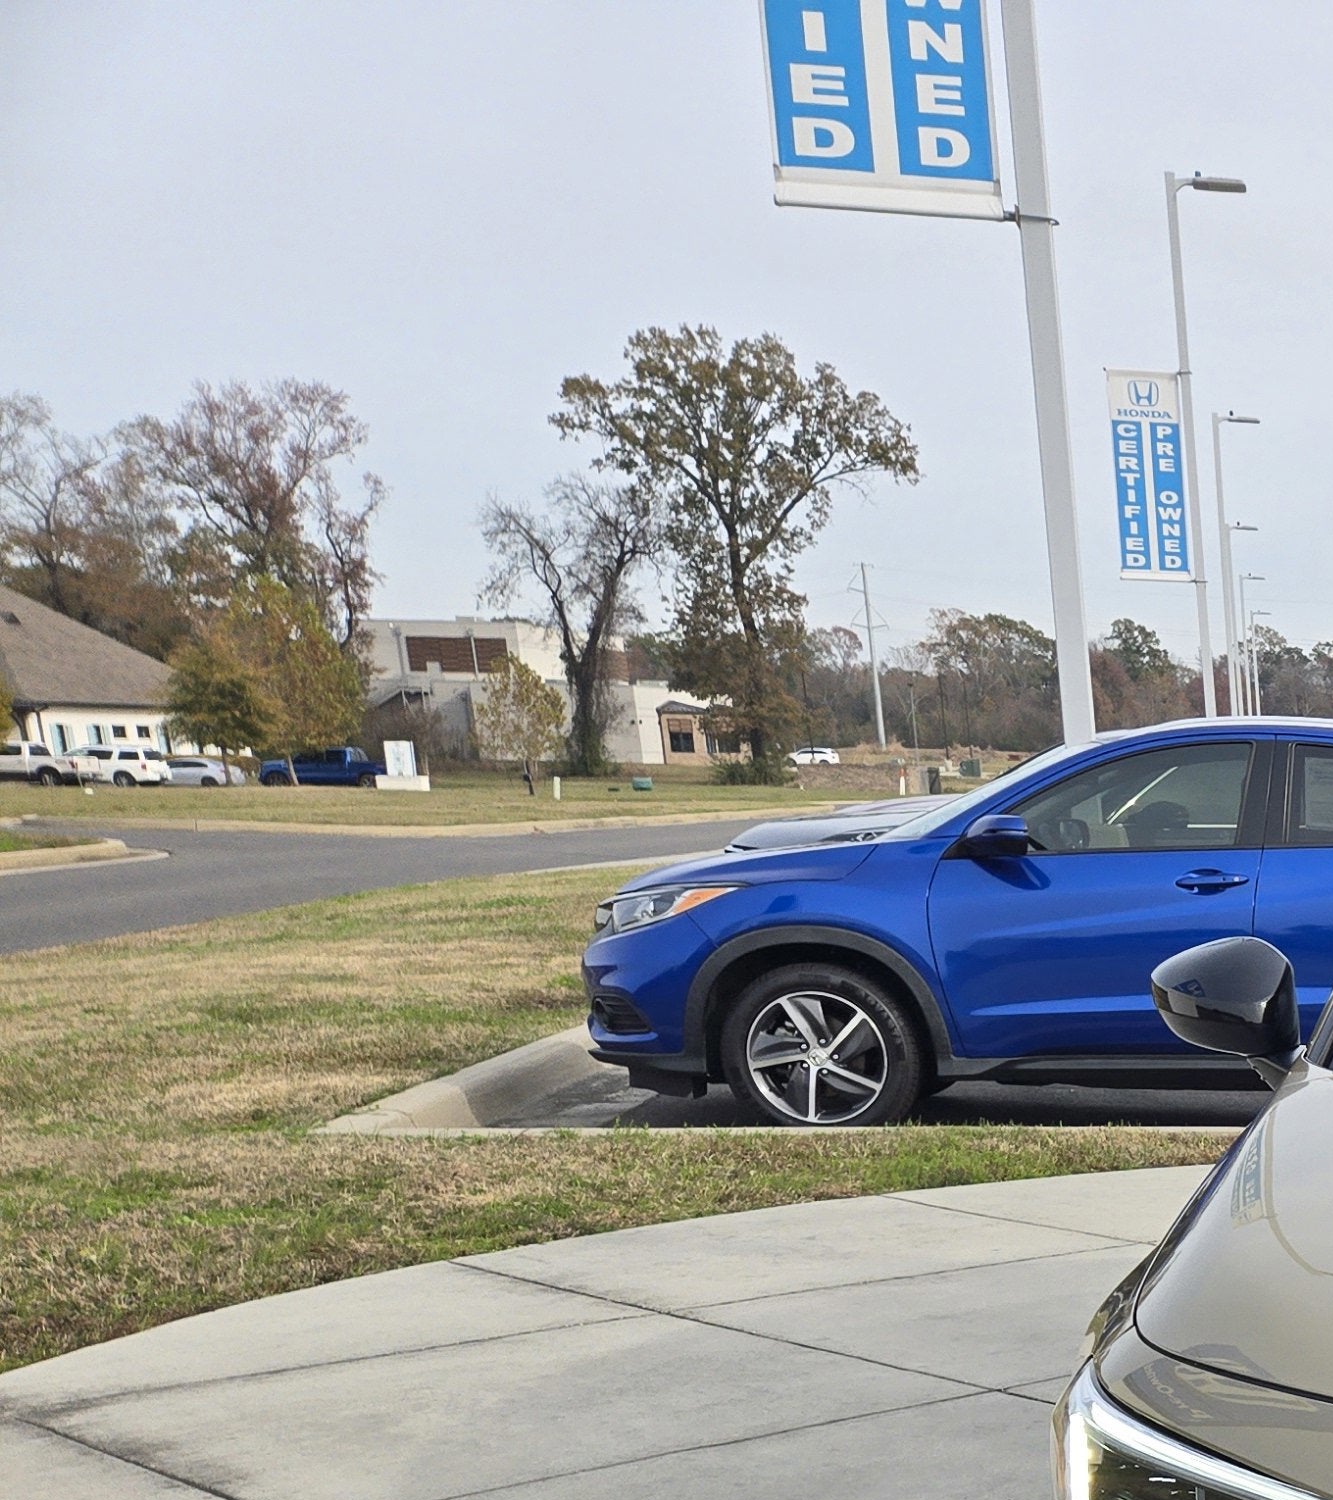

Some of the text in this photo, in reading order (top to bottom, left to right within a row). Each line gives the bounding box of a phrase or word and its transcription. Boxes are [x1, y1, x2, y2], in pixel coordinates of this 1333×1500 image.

[904, 0, 971, 168] NED
[1117, 408, 1173, 419] HONDA
[1116, 423, 1146, 567] CERTIFIED
[1156, 426, 1182, 569] PRE OWNED
